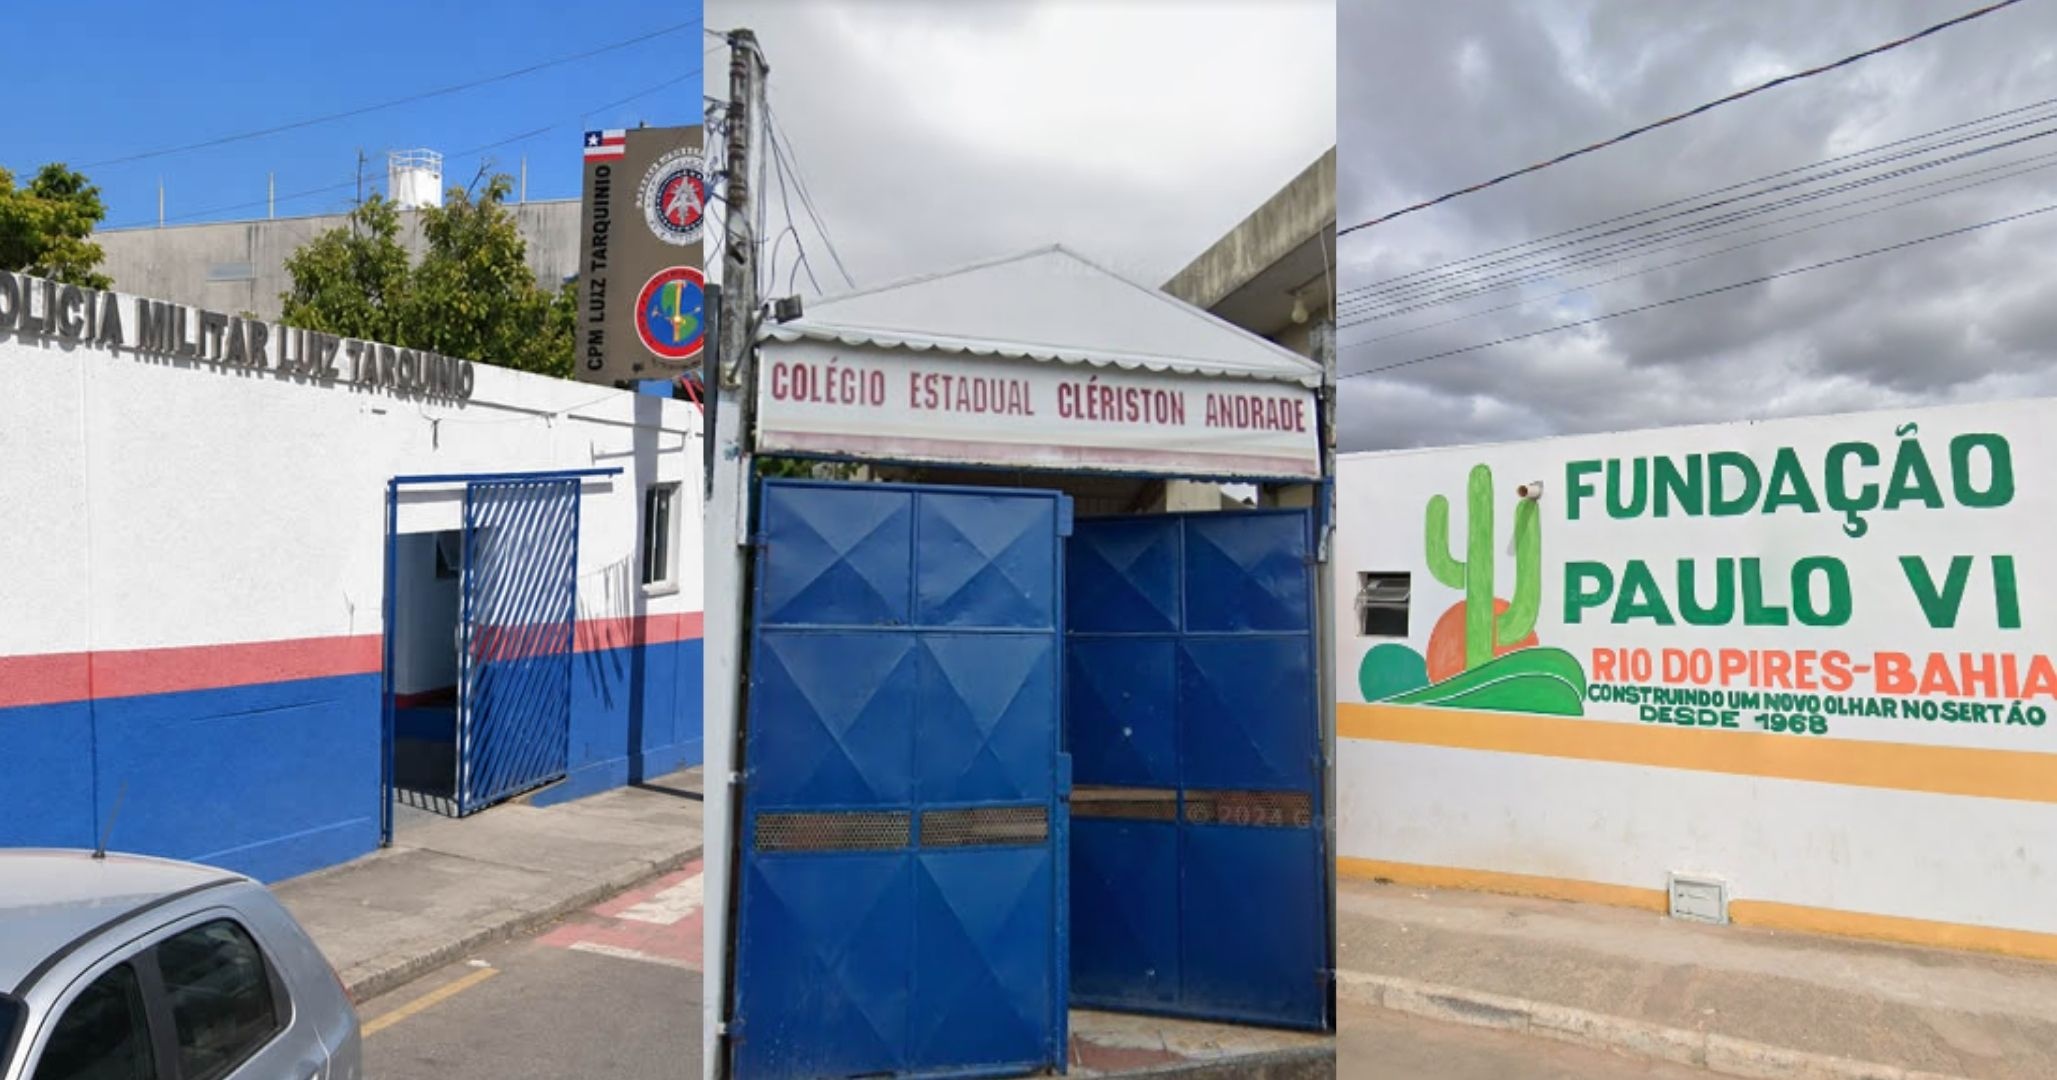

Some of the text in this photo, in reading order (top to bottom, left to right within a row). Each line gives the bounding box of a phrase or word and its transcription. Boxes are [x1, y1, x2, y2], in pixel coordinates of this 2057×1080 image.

[586, 164, 611, 372] CPM LUIZ TARQUINIO
[135, 297, 268, 369] MILITAR
[276, 325, 341, 378] LUIZ
[345, 336, 475, 401] TARQUINIO
[771, 357, 1307, 433] COLÉGIO ESTADUAL CLÉRISTON ANDRADE
[1566, 422, 2015, 538] FUNDAÇÃO
[1563, 555, 2022, 629] PAULO VI
[1588, 683, 1724, 707] CONSTRUINDO
[1728, 692, 1760, 710] UM
[1764, 693, 1821, 714] NOVO
[1824, 696, 1898, 719] OLHAR
[1901, 700, 1938, 721] NO
[1592, 648, 1652, 683] RIO
[1662, 648, 1713, 685] DO
[1640, 705, 1829, 735] DESDE 1968
